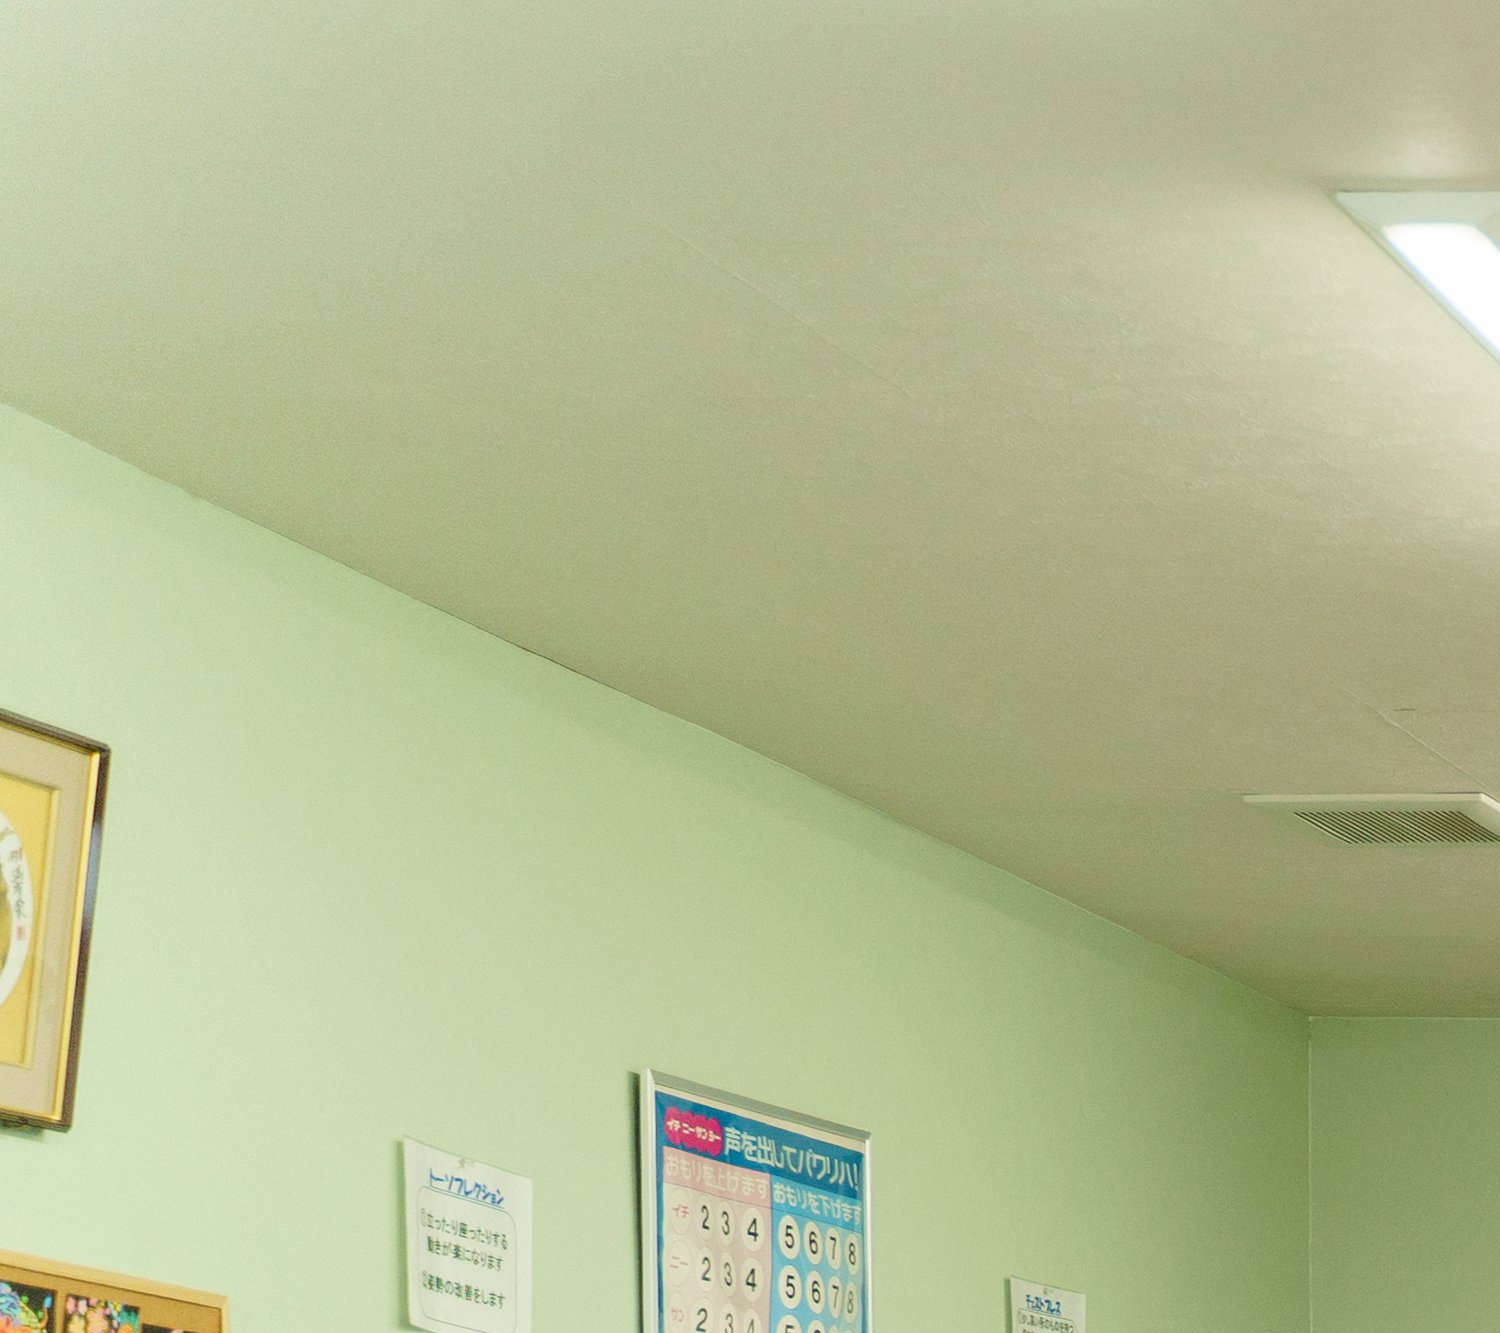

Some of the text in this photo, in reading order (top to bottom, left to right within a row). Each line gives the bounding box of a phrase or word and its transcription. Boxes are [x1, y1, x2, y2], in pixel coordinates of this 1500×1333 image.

[665, 1158, 770, 1199] おもりを上げます
[773, 1183, 862, 1226] おもりを下げます
[701, 1205, 710, 1231] 2
[721, 1211, 731, 1236] 3
[747, 1217, 759, 1243] 4
[784, 1222, 795, 1249] 5
[809, 1231, 819, 1255] 6
[829, 1236, 837, 1260] 7
[848, 1242, 856, 1266] 8
[701, 1257, 711, 1281] 2
[723, 1262, 733, 1286] 3
[745, 1268, 757, 1291] 4
[785, 1275, 796, 1300] 5
[812, 1281, 821, 1303] 6
[832, 1285, 839, 1309] 7
[847, 1290, 854, 1311] 8
